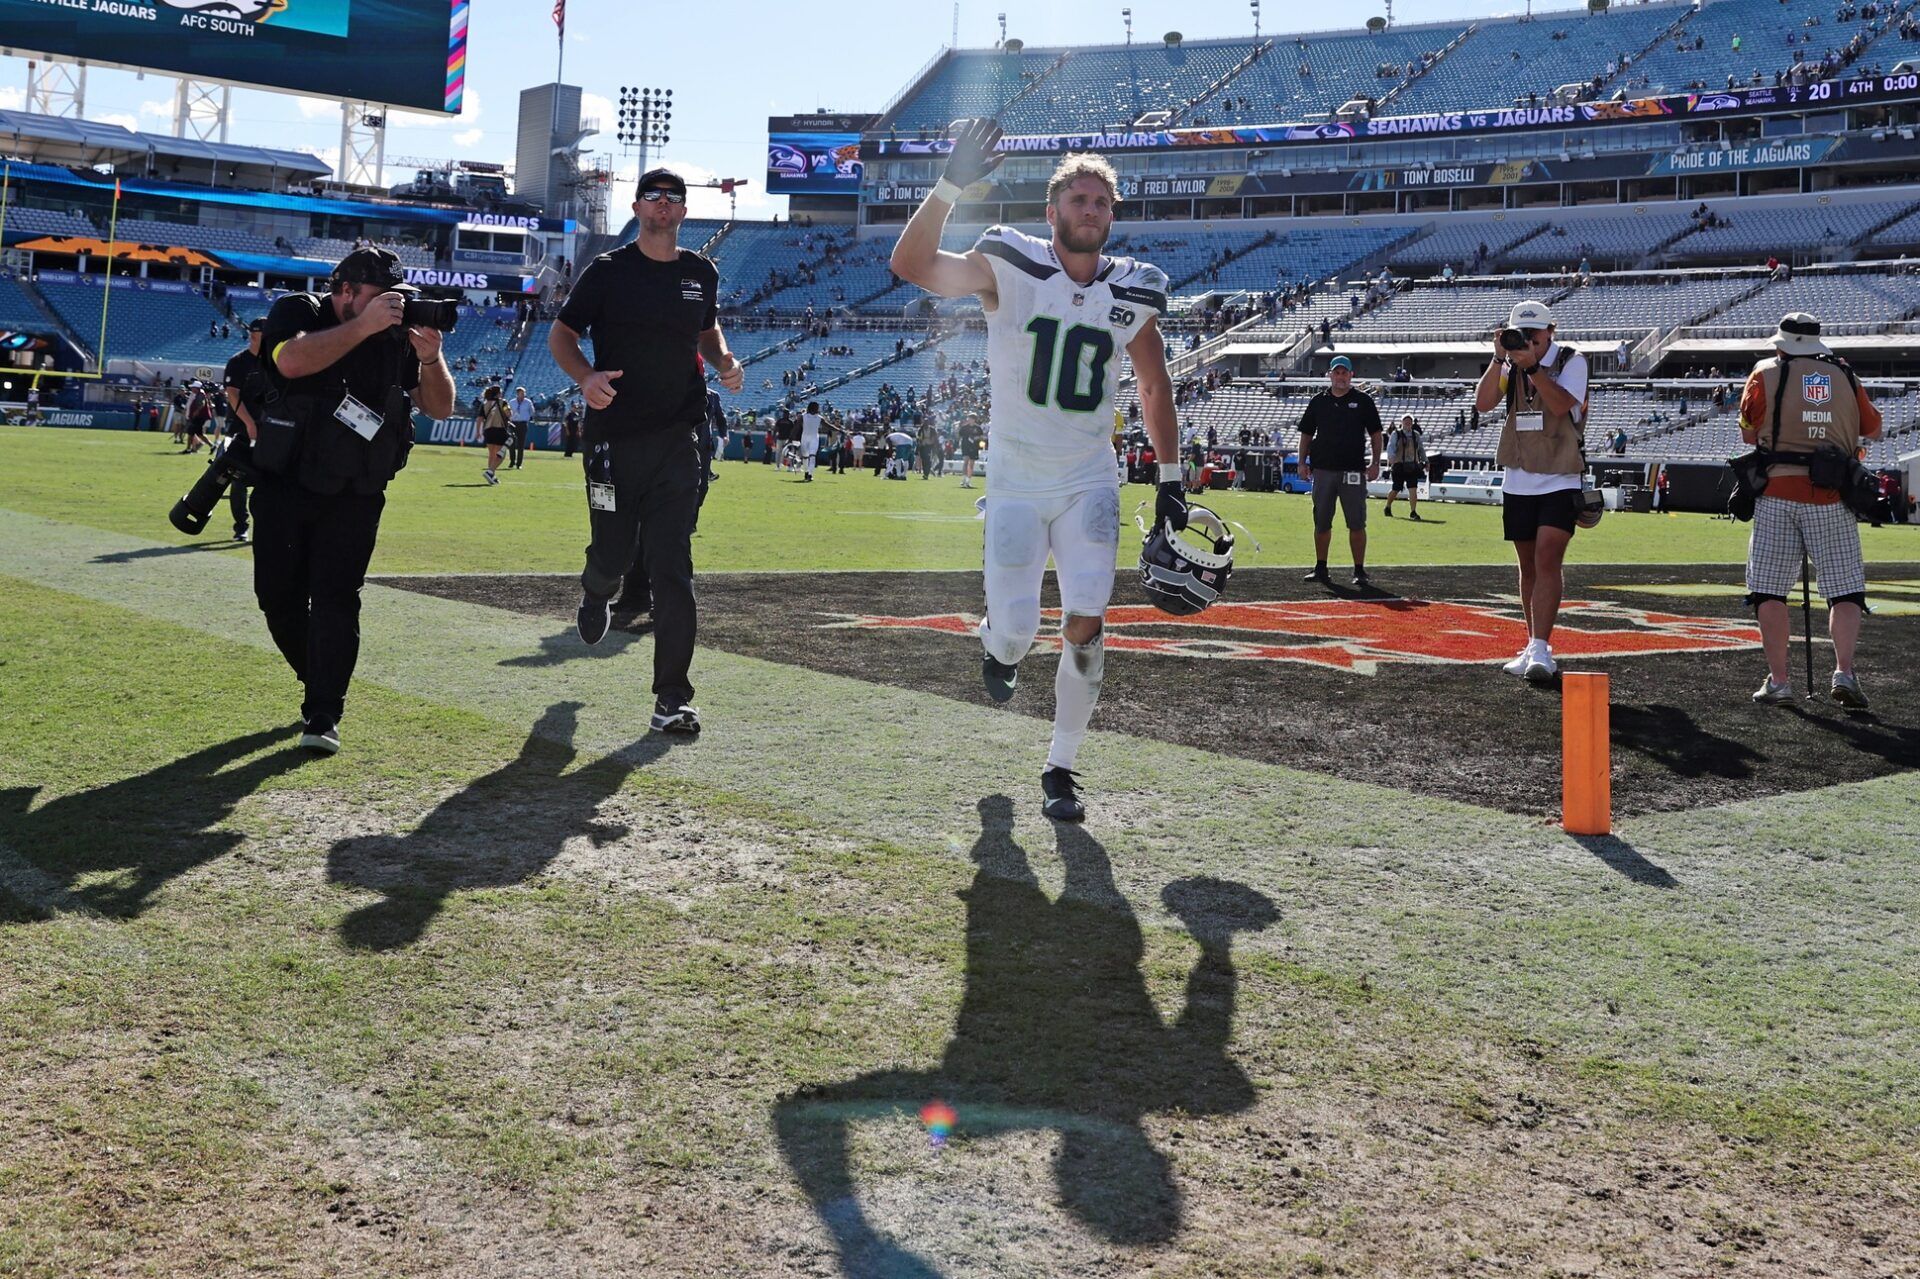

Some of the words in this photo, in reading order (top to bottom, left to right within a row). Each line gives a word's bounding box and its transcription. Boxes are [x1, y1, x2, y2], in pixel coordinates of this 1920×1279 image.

[91, 0, 157, 21] JAGUARS
[180, 14, 207, 30] AFC
[210, 18, 255, 37] SOUTH
[1808, 83, 1831, 100] 20
[1849, 81, 1874, 94] 4TH
[1883, 75, 1918, 91] 0:00
[1790, 93, 1797, 102] 2
[1367, 114, 1462, 135] SEAHAWKS
[1469, 114, 1487, 127] VS
[1493, 106, 1575, 127] JAGUARS
[992, 136, 1060, 151] AHAWKS
[1066, 137, 1082, 148] VS
[1087, 132, 1158, 149] JAGUARS
[811, 154, 828, 167] VS
[1670, 152, 1705, 169] PRIDE
[1708, 151, 1723, 167] OF
[1727, 149, 1750, 165] THE
[1753, 145, 1811, 164] JAGUARS
[1403, 169, 1430, 185] TONY
[1433, 168, 1475, 184] BOSELLI
[879, 187, 891, 200] HC
[894, 187, 912, 200] TOM
[1144, 181, 1168, 195] FRED
[1171, 179, 1206, 194] TAYLOR
[463, 212, 540, 231] JAGUARS
[403, 269, 488, 288] JAGUARS
[1109, 306, 1135, 326] 50
[1025, 314, 1113, 413] 10
[1806, 385, 1829, 400] NFL
[47, 413, 93, 426] JAGUARS
[1802, 411, 1832, 423] MEDIA
[1808, 427, 1826, 439] 179
